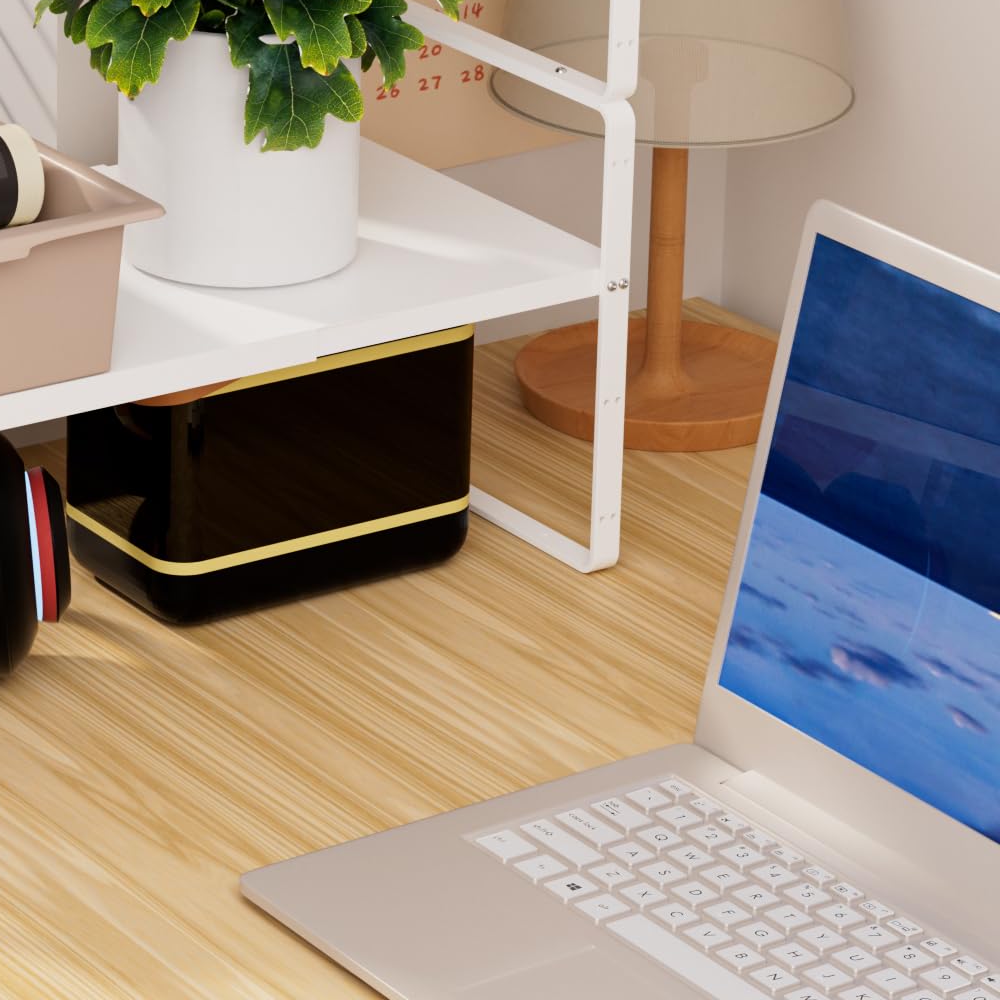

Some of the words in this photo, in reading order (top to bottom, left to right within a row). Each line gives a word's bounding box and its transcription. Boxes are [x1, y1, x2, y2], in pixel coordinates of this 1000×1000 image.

[464, 2, 484, 20] 14
[419, 44, 442, 60] 20
[376, 84, 400, 100] 26
[418, 76, 442, 92] 27
[460, 64, 485, 84] 28
[685, 852, 700, 860] W
[766, 973, 783, 982] N
